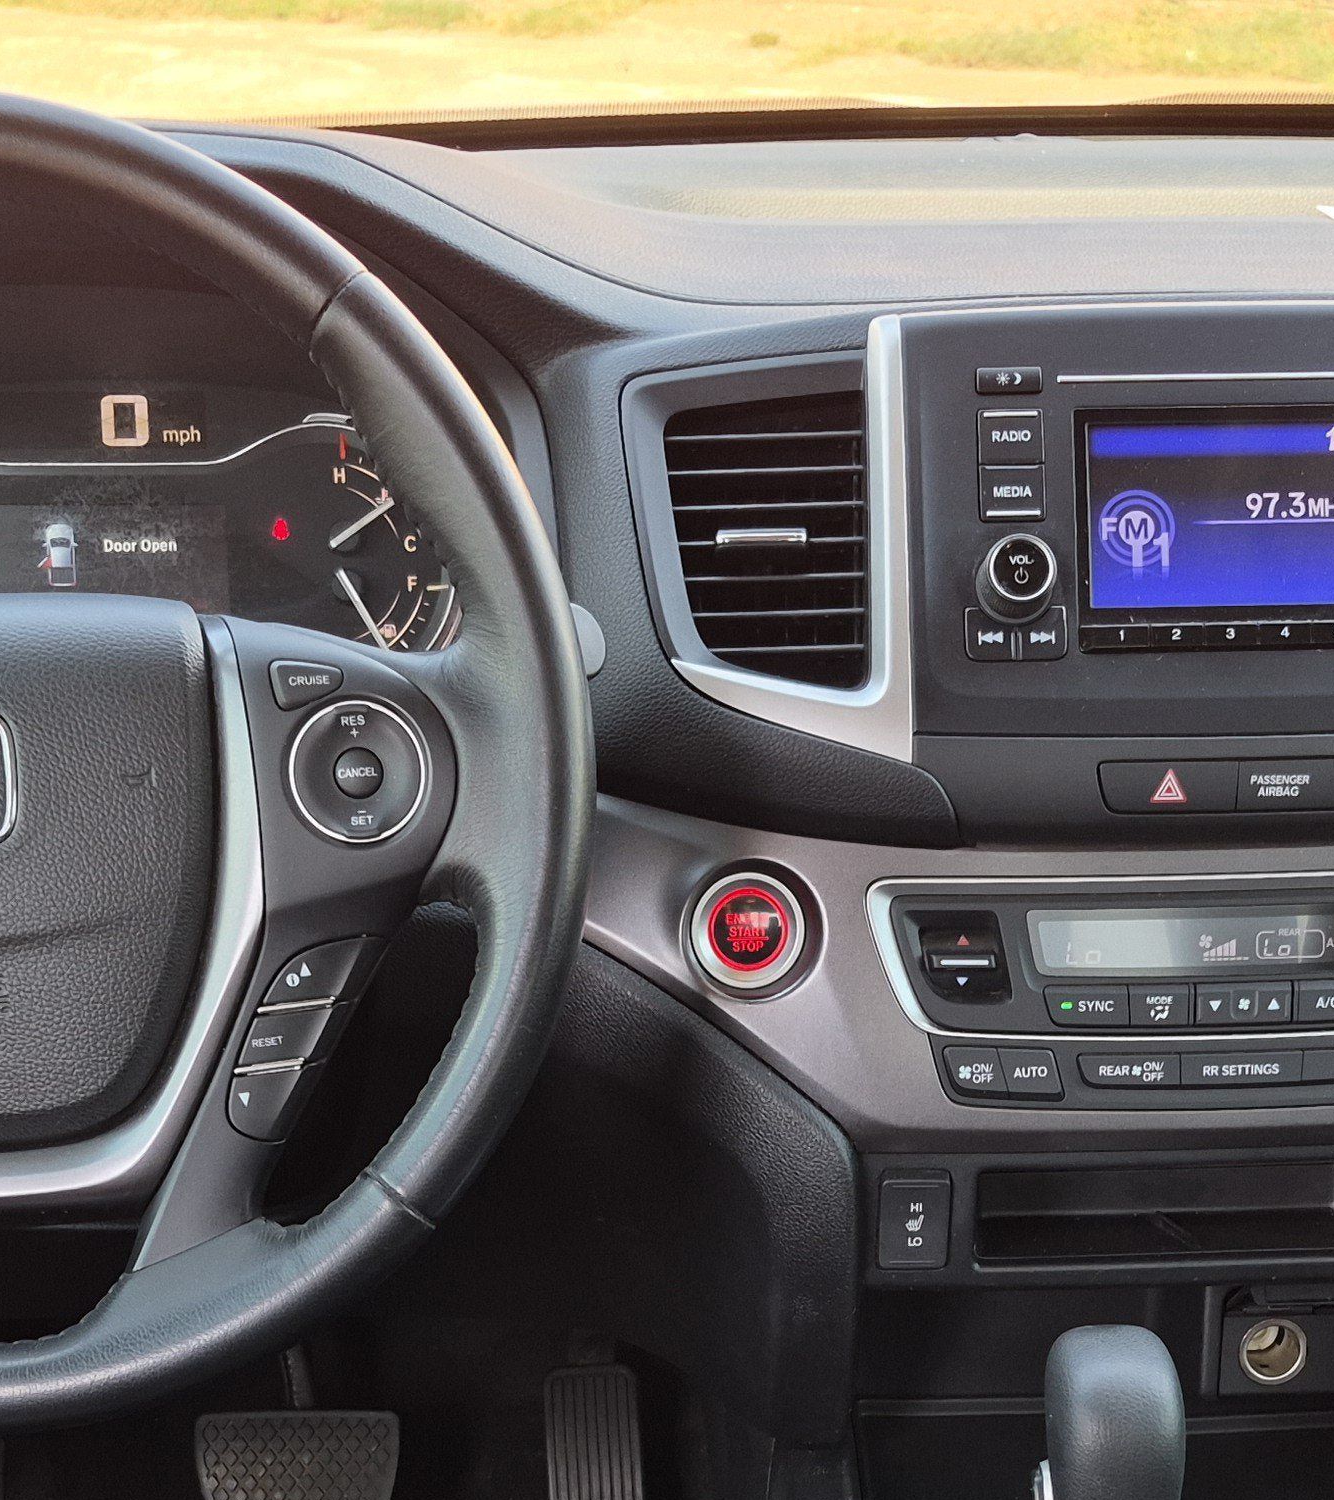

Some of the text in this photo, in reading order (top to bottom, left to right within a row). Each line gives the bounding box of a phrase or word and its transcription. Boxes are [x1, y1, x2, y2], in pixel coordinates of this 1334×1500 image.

[100, 394, 202, 447] 0 mph
[991, 428, 1032, 444] RADIO
[333, 467, 346, 484] H
[993, 486, 1032, 498] MEDIA
[103, 538, 178, 554] Door Open
[404, 535, 417, 553] C
[407, 575, 418, 592] F
[1118, 628, 1125, 642] 1
[1171, 628, 1181, 641] 2
[1225, 627, 1236, 640] 3
[1280, 626, 1290, 639] 4
[288, 674, 330, 687] CRUISE
[340, 714, 365, 728] RES
[337, 766, 378, 779] CANCEL
[1249, 773, 1310, 787] PASSENGER
[1256, 786, 1300, 798] AIRBAG
[351, 814, 374, 827] SET
[729, 927, 765, 937] START
[1278, 928, 1301, 937] REAR
[733, 941, 763, 952] STOP
[1078, 1000, 1114, 1013] SYNC
[1146, 996, 1173, 1005] MODE
[251, 1035, 284, 1049] RESET
[1014, 1067, 1048, 1079] AUTO
[1099, 1065, 1129, 1077] REAR
[1203, 1063, 1279, 1077] RR SETTINGS
[972, 1073, 994, 1084] OFF
[1143, 1072, 1165, 1083] OFF
[910, 1202, 923, 1213] HI
[907, 1236, 923, 1247] LO
